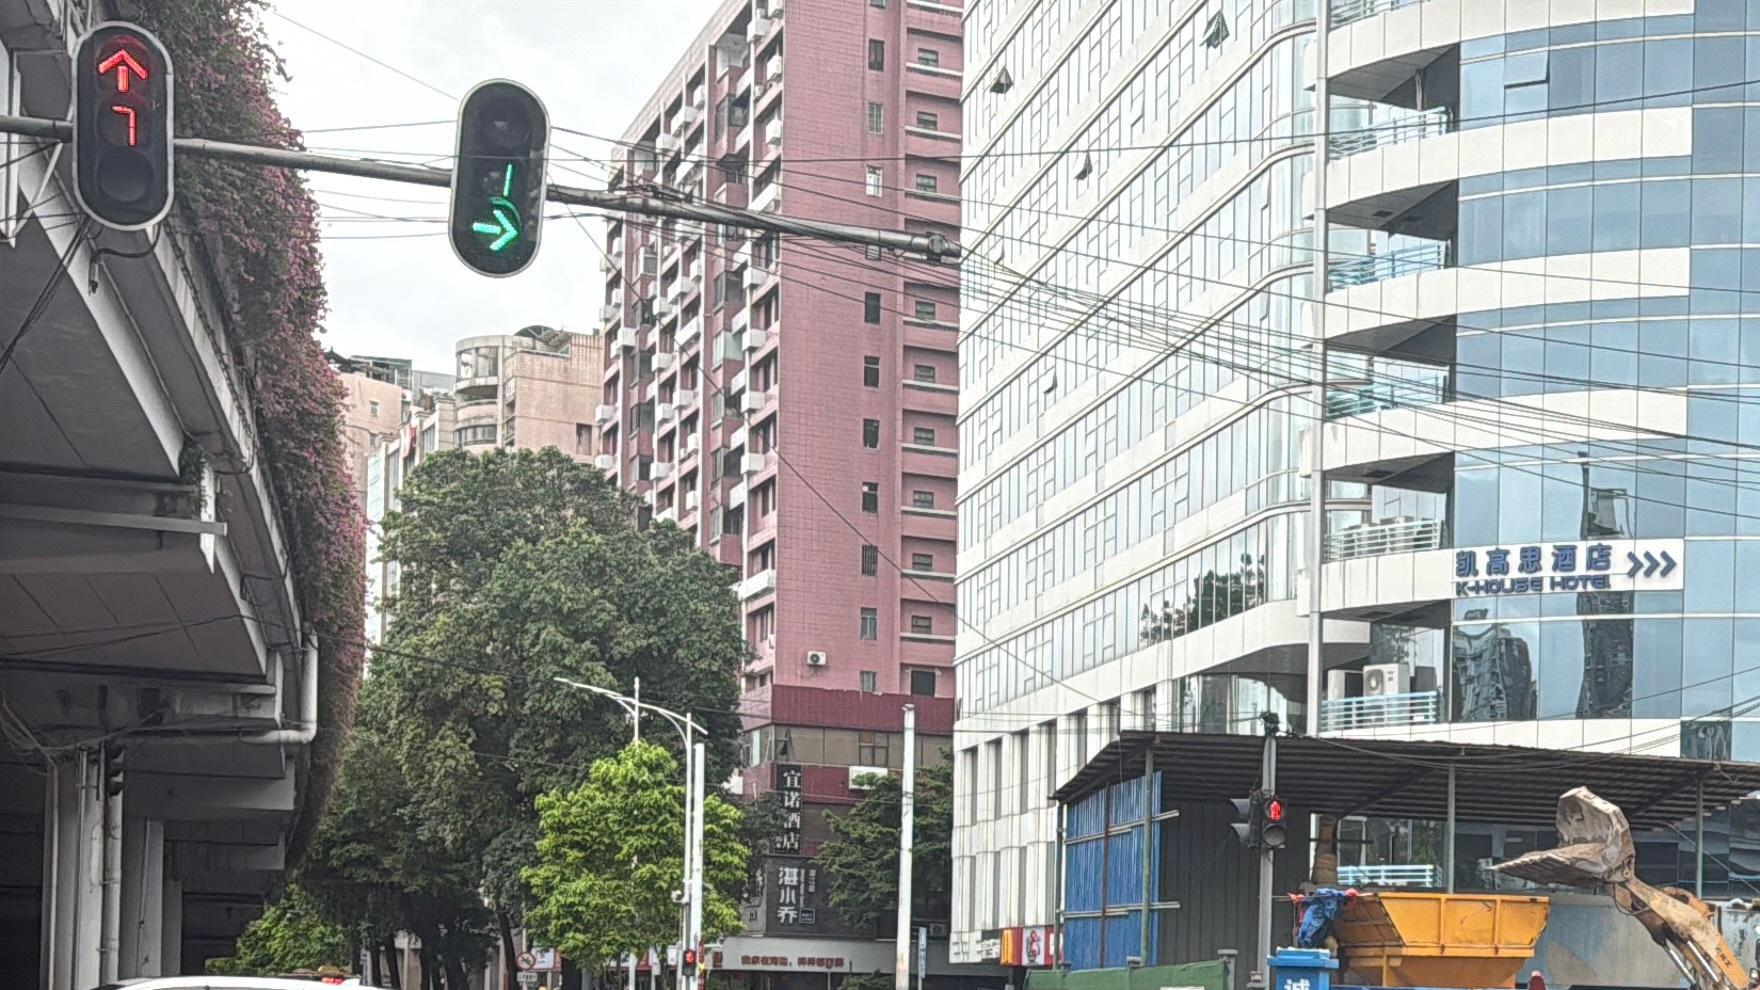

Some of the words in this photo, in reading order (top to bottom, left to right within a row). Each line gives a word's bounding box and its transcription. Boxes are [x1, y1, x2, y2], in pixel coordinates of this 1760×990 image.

[1455, 542, 1613, 577] 凯高思酒店
[1455, 577, 1543, 596] K-HOUSE
[1550, 574, 1611, 592] HOTEL
[782, 769, 801, 850] 宜诺酒店
[777, 866, 798, 924] 湛小乔
